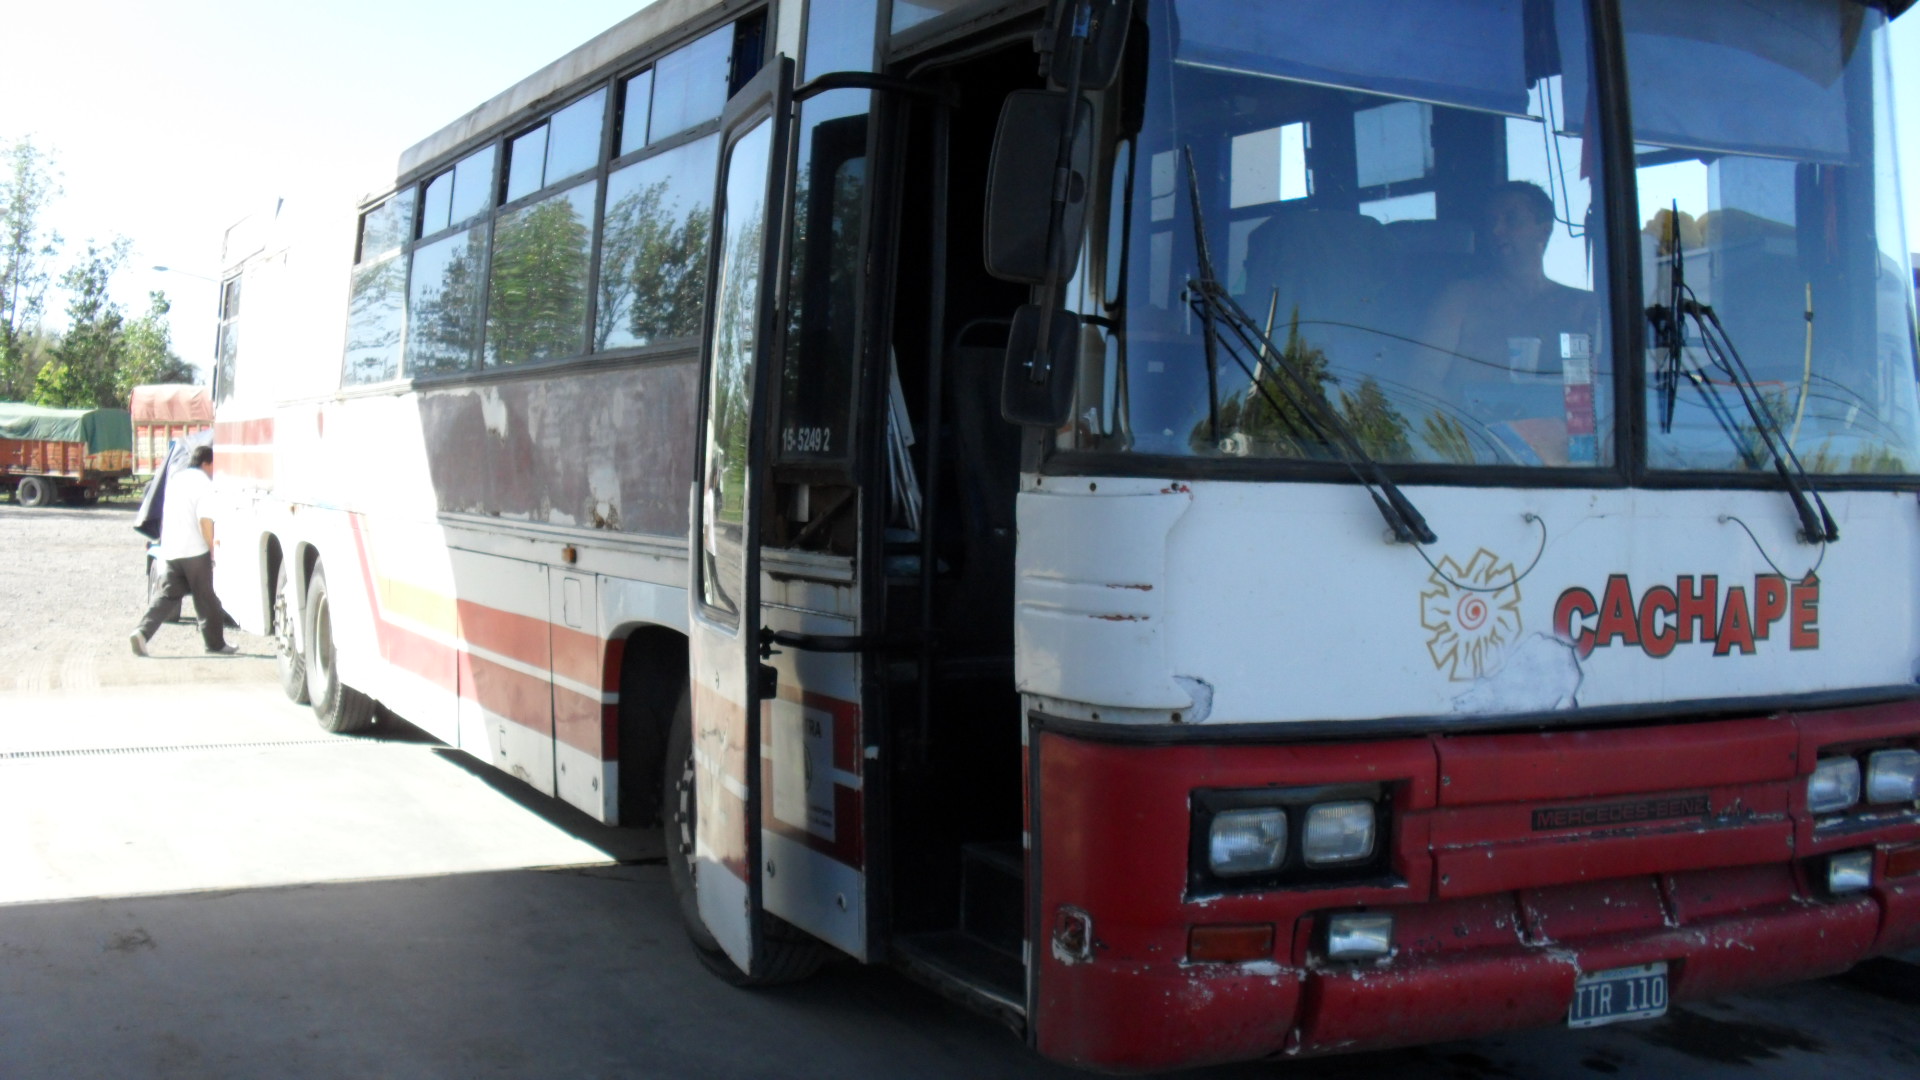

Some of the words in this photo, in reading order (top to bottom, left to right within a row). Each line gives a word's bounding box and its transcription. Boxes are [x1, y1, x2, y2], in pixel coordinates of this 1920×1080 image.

[1553, 568, 1820, 660] CACHAPÉ
[1537, 797, 1705, 827] MERCEDES-BENZ
[1576, 983, 1612, 1018] TTR
[1626, 976, 1664, 1011] 110
